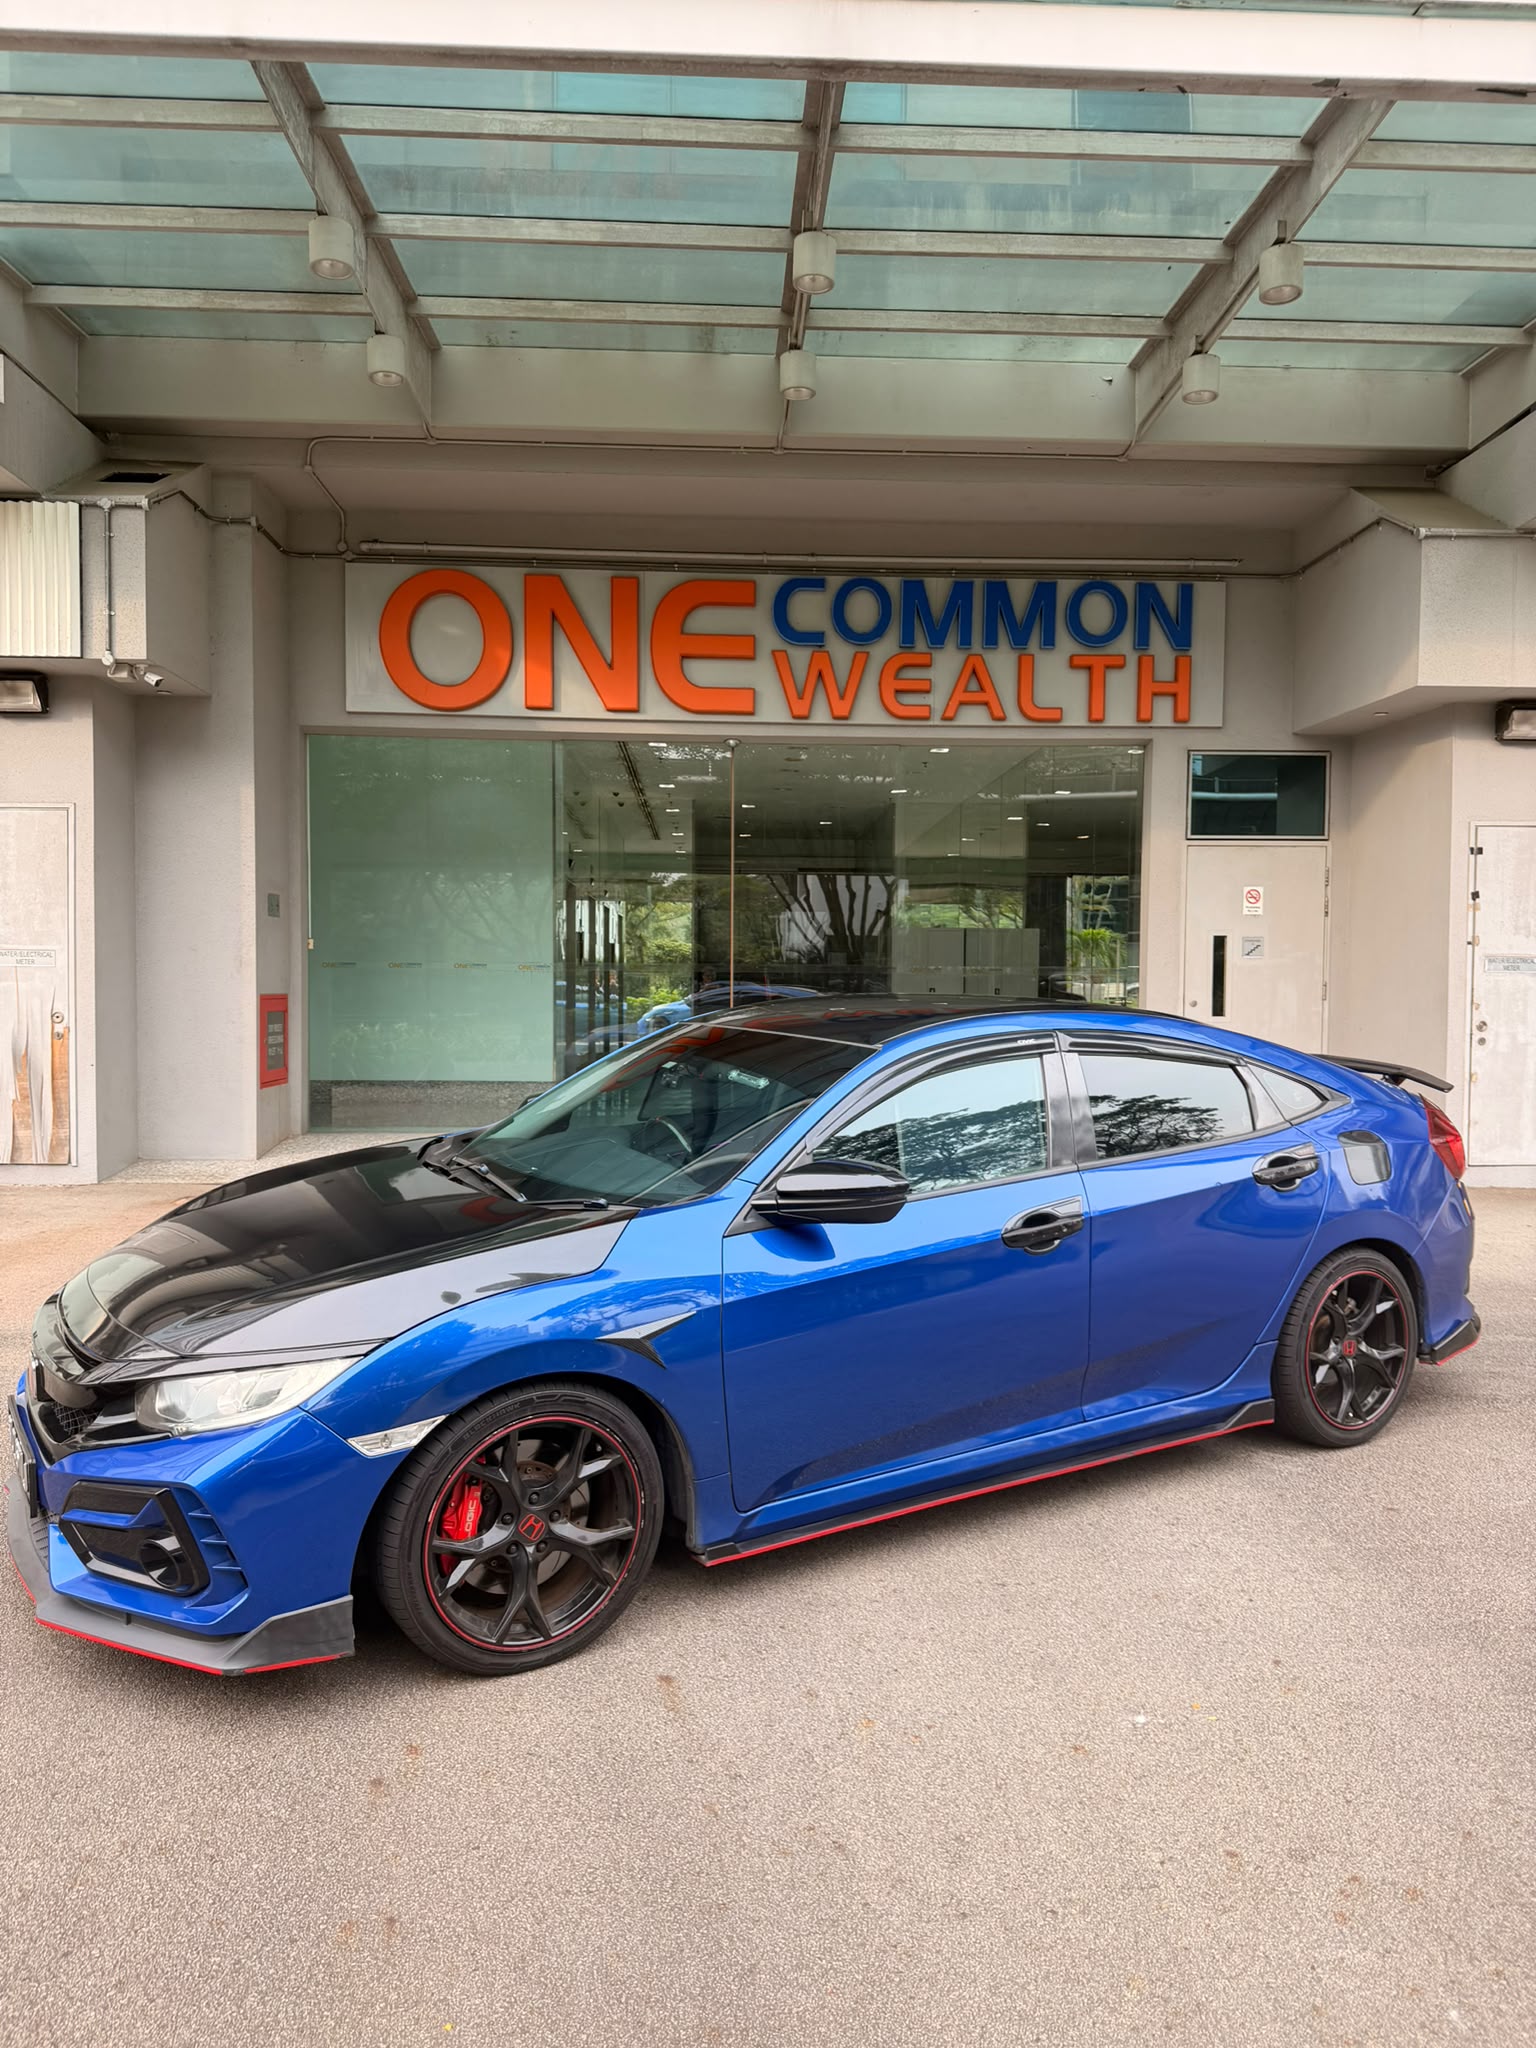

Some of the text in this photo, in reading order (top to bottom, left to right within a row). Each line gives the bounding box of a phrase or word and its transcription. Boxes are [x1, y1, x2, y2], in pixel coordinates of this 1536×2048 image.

[379, 568, 756, 715] ONE
[772, 577, 1194, 650] COMMON
[771, 650, 1192, 723] WEALTH
